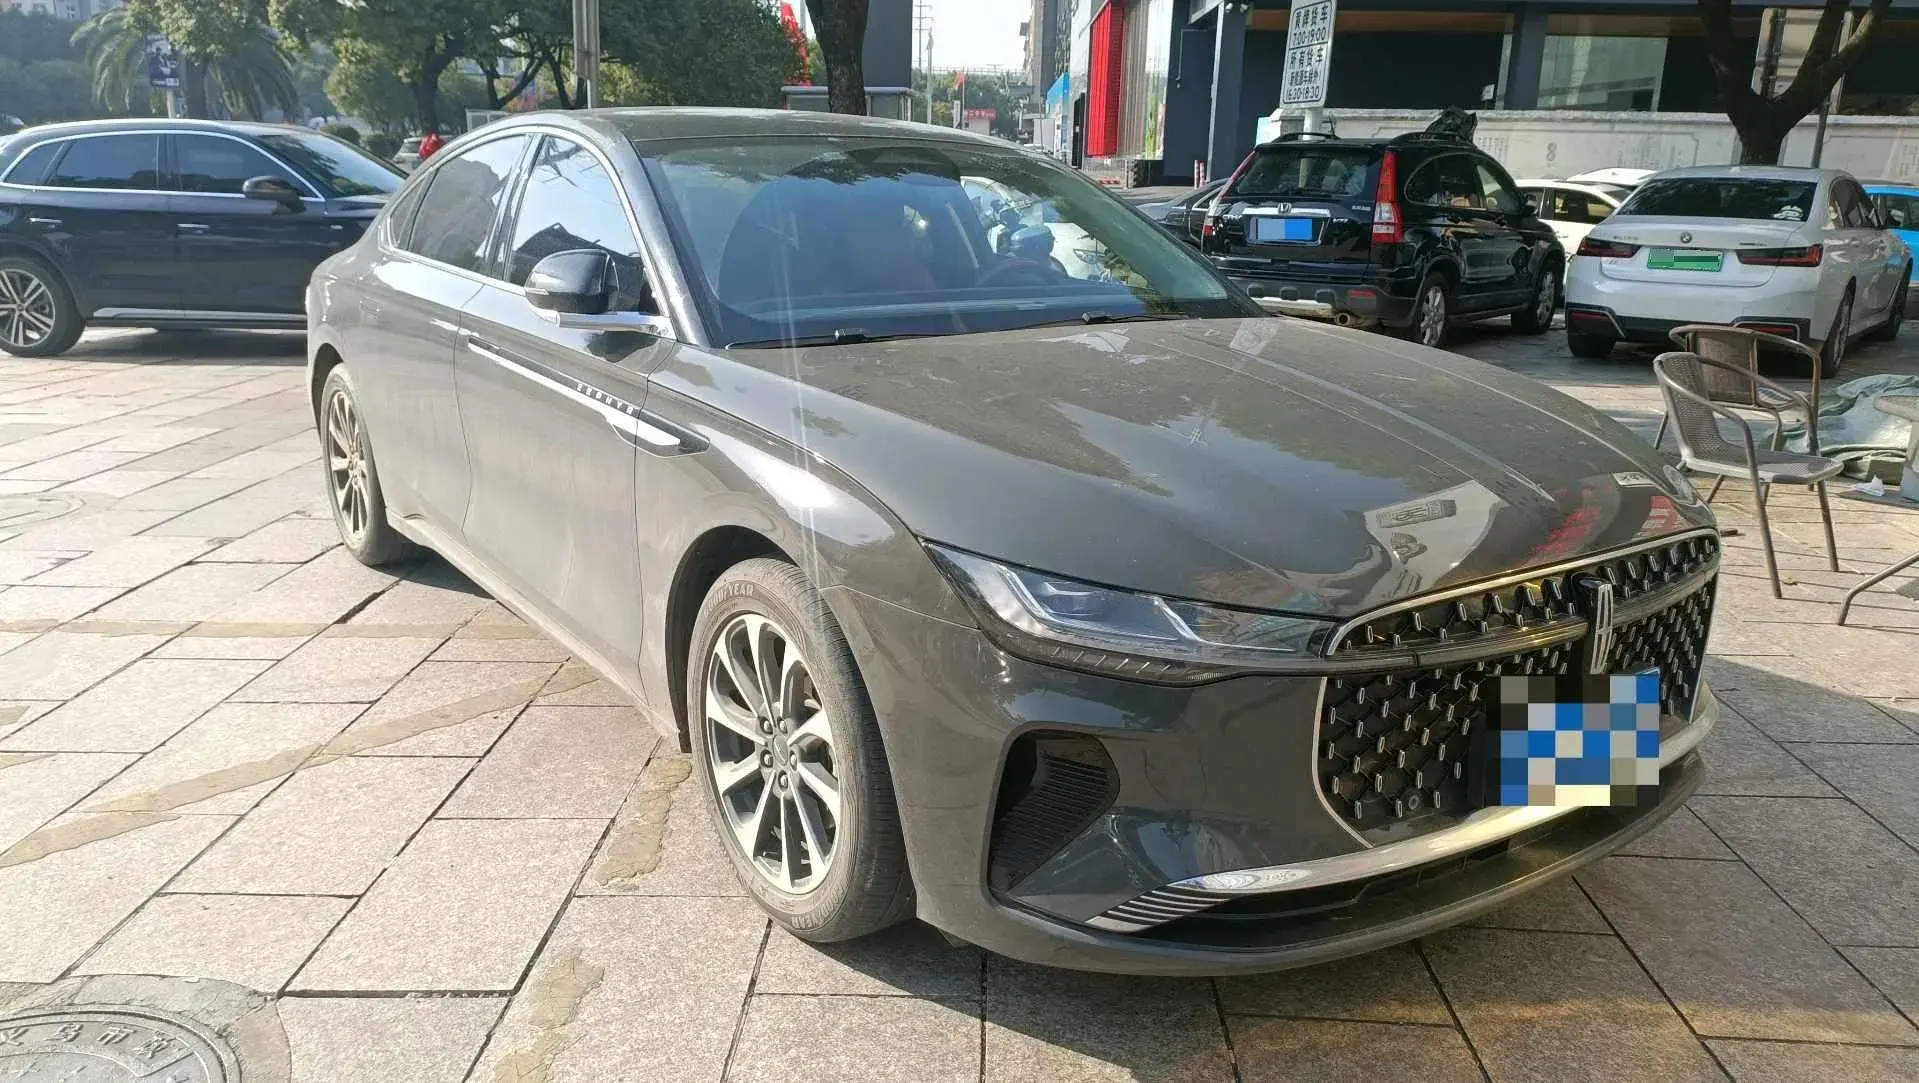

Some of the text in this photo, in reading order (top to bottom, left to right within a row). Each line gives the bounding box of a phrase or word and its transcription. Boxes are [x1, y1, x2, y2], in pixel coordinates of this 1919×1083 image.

[1295, 5, 1328, 28] 黄牌货车
[1289, 48, 1323, 68] 所有货车
